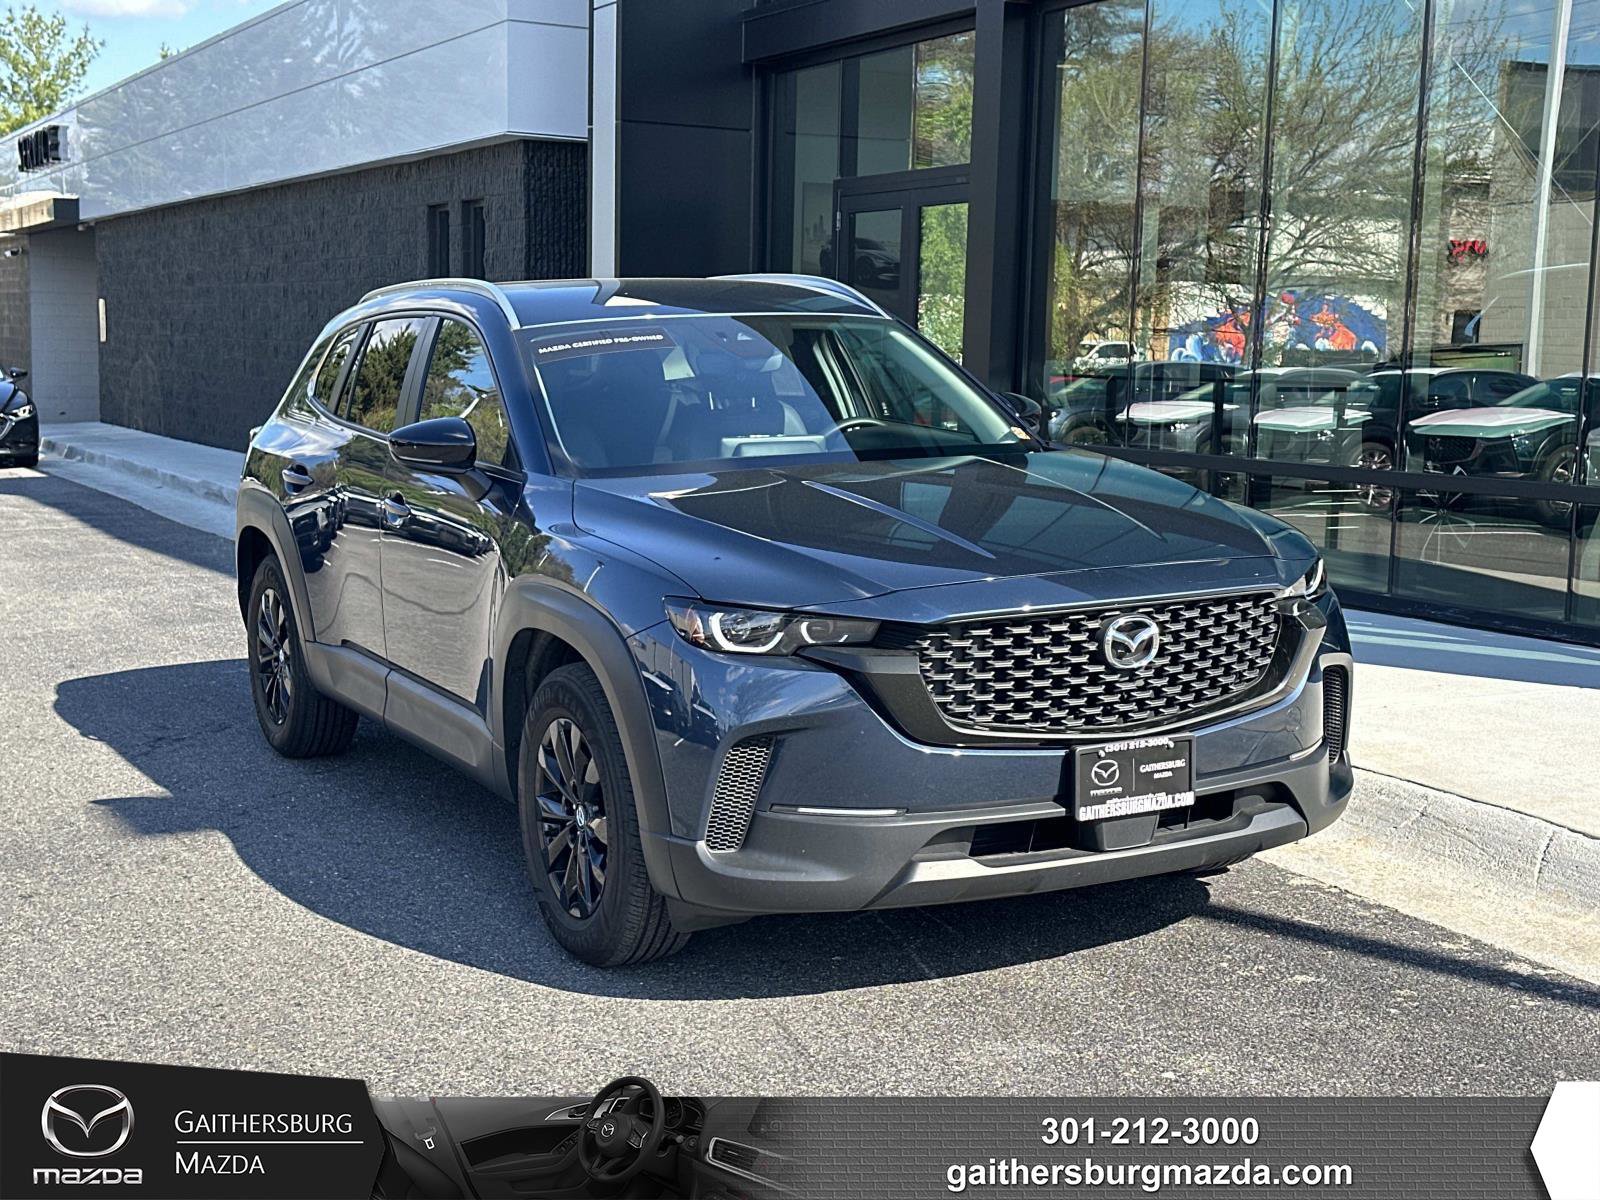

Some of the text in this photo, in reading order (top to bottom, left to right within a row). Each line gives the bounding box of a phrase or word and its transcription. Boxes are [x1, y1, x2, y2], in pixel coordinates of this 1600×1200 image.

[538, 334, 664, 354] MAZDA CERTIFIED PRE-OWNED
[1128, 737, 1169, 750] 212-3000
[1139, 759, 1186, 773] GAITHERSBURG
[1153, 771, 1173, 779] MAZDA
[1080, 791, 1195, 821] GAITHERSBURGMAZDA.COM
